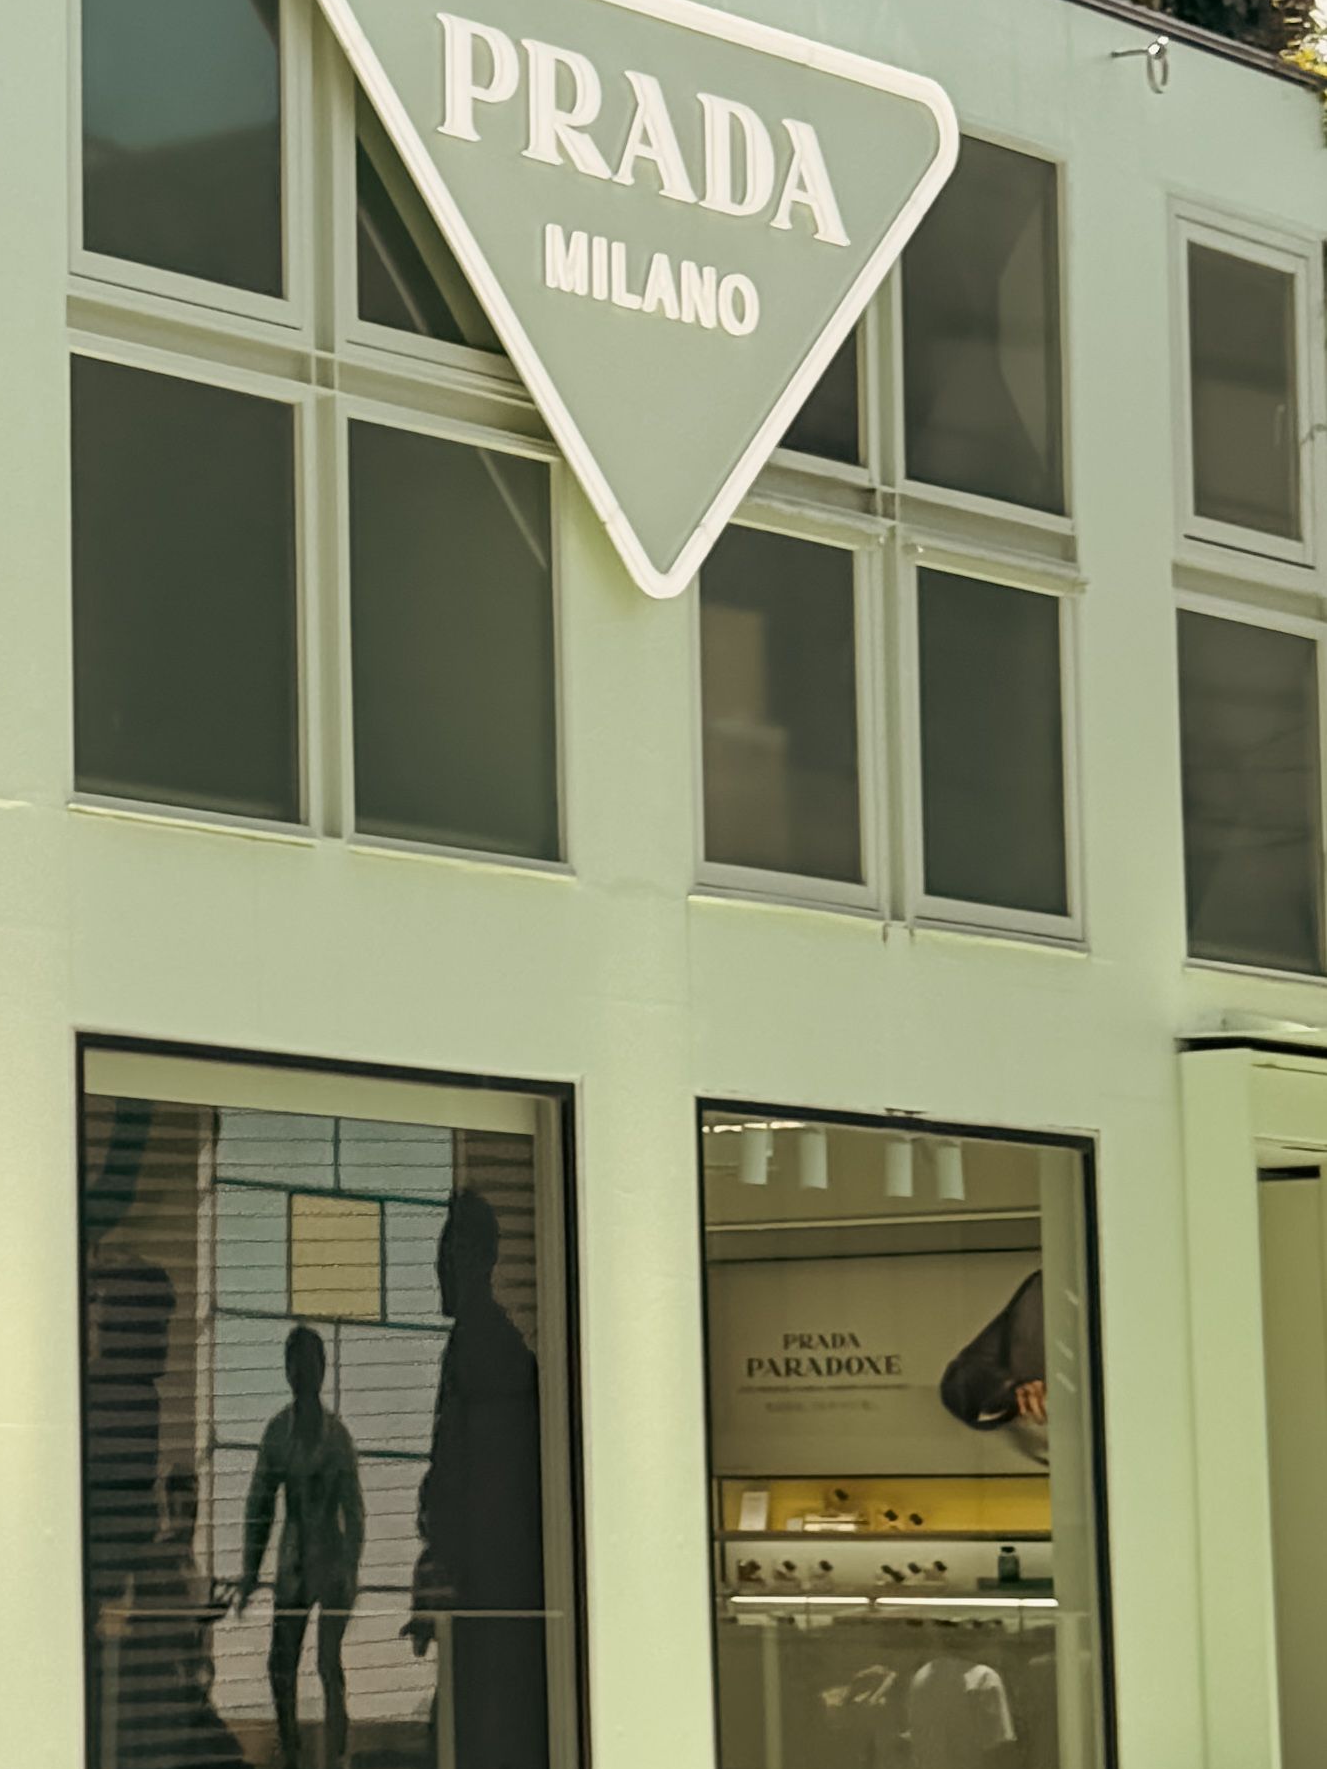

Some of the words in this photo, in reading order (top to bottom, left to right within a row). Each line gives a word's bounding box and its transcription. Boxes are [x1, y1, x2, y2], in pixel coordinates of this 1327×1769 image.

[436, 11, 851, 247] PRADA
[544, 223, 760, 337] MILANO
[746, 1355, 902, 1378] PARADOXE
[782, 1333, 861, 1350] PRADA
